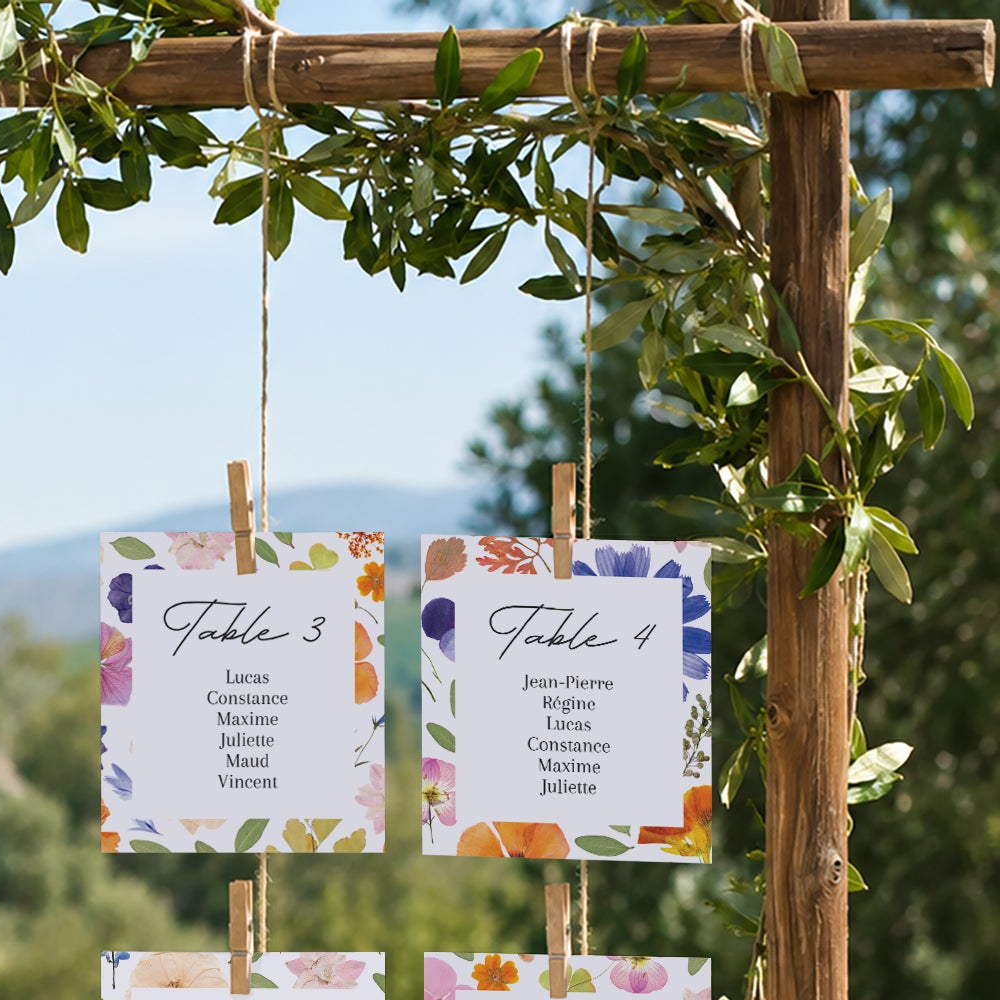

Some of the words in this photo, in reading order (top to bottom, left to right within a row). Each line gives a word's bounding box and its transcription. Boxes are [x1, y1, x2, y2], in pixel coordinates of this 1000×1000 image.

[162, 598, 290, 657] Table
[302, 616, 327, 643] 3
[488, 603, 618, 661] Table
[633, 623, 657, 650] 4
[226, 669, 270, 685] Lucas
[521, 674, 614, 692] Jean-Pierre
[206, 690, 289, 706] Constance
[543, 695, 596, 715] Régine
[217, 711, 279, 726] Maxime
[546, 715, 592, 732] Lucas
[218, 731, 275, 750] Juliette
[527, 736, 611, 754] Constance
[226, 753, 269, 769] Maud
[538, 757, 601, 775] Maxime
[217, 774, 278, 790] Vincent
[539, 778, 597, 797] Juliette
